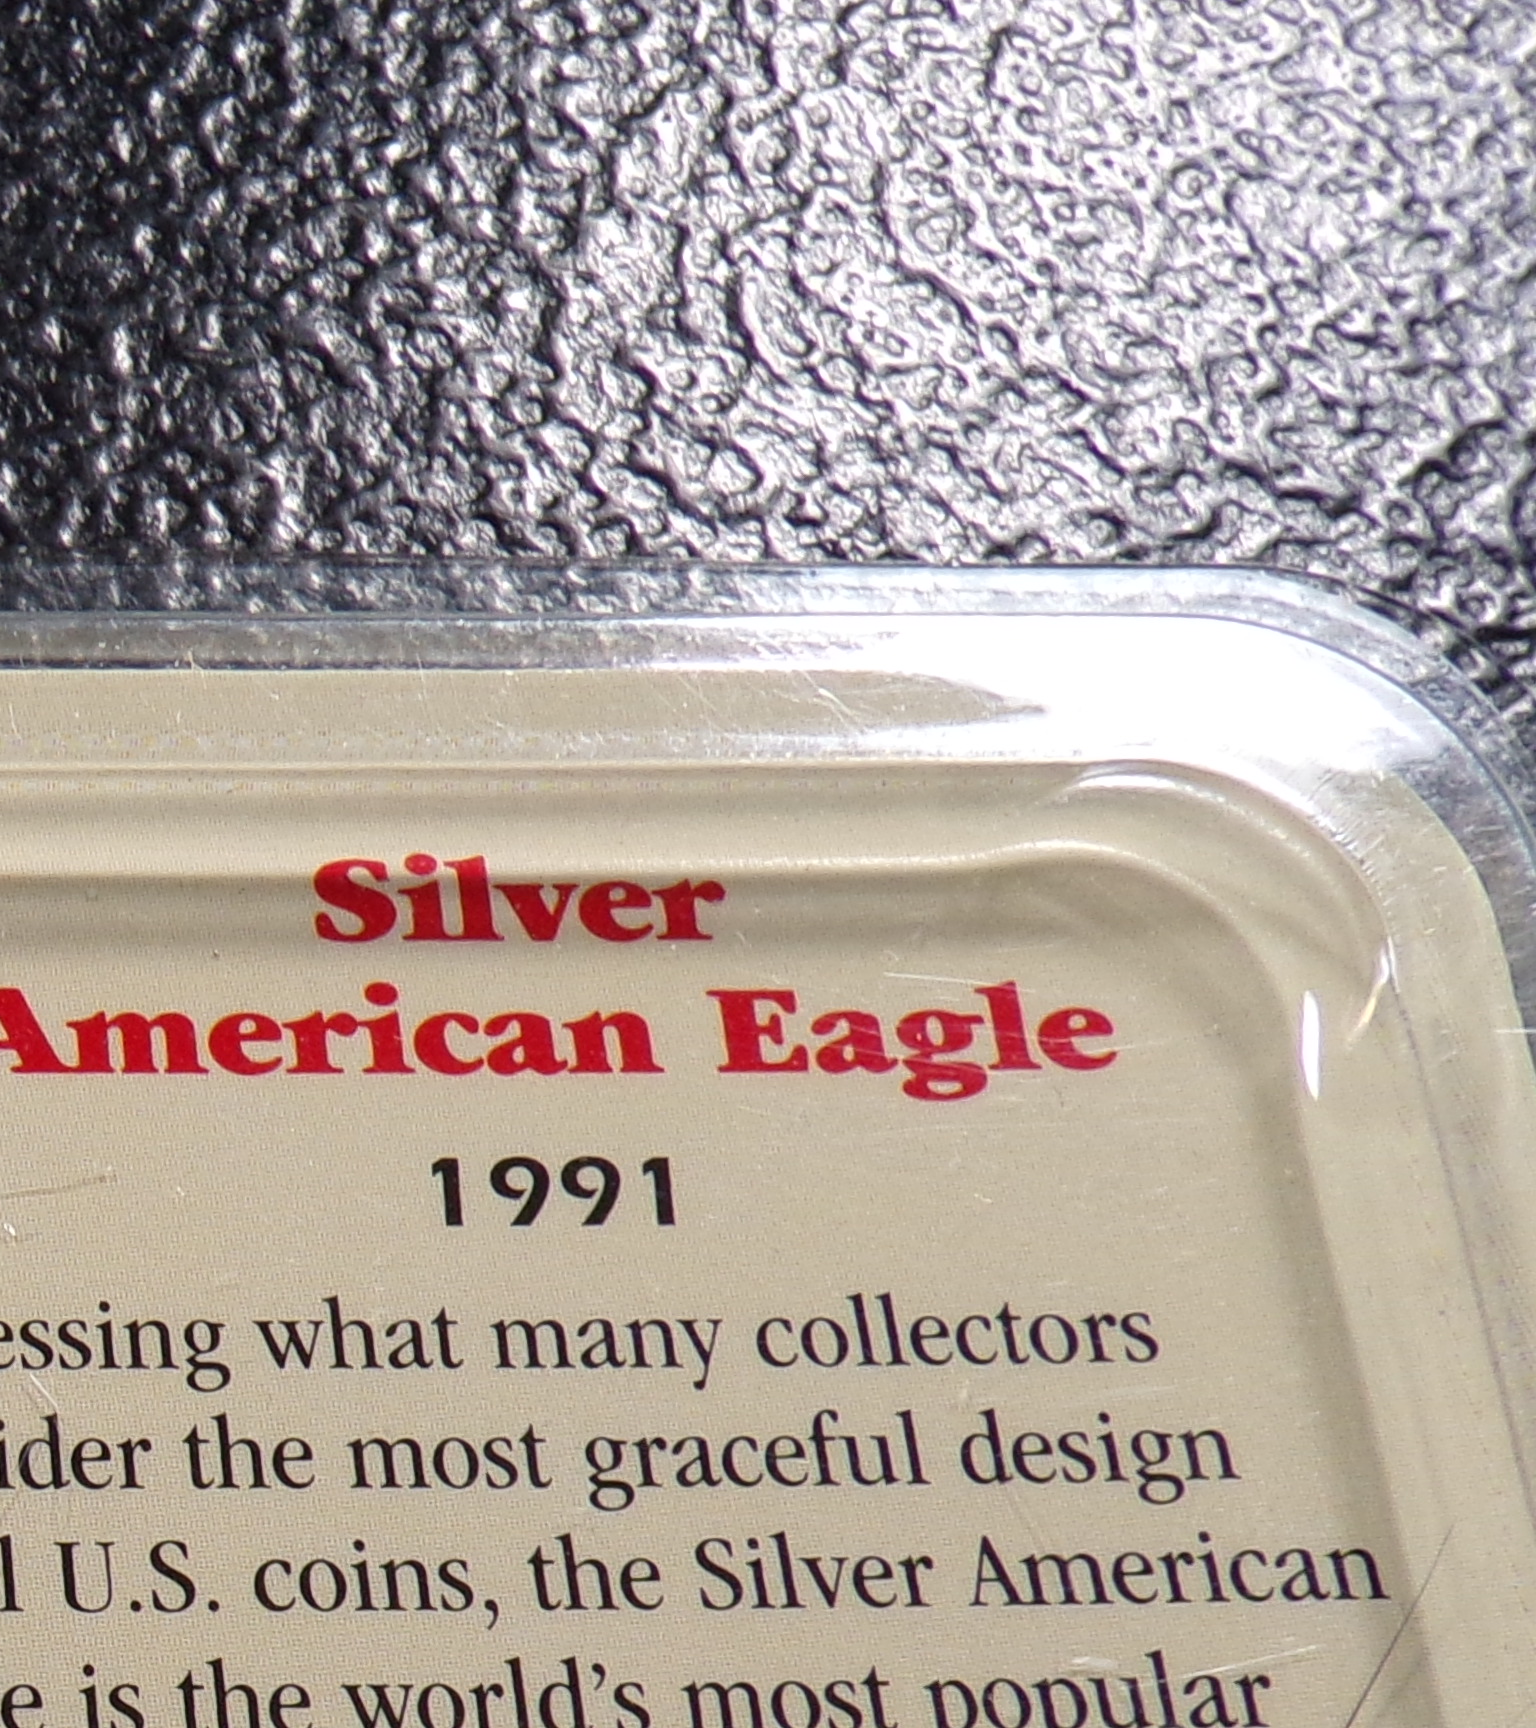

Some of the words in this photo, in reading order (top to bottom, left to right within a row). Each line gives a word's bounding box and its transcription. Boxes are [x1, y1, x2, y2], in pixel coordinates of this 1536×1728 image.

[313, 852, 726, 943] Silver
[706, 980, 1119, 1102] Eagle
[431, 1156, 679, 1228] 1991
[253, 1295, 464, 1370] what
[490, 1318, 722, 1391] many
[756, 1292, 1160, 1368] collectors
[182, 1413, 315, 1490] the
[347, 1424, 553, 1490] most
[584, 1408, 931, 1513] graceful
[960, 1407, 1240, 1505] design
[53, 1540, 220, 1614] U.S.
[252, 1539, 502, 1629] coins,
[529, 1535, 664, 1611] the
[694, 1532, 934, 1611] Silver
[969, 1530, 1391, 1607] American
